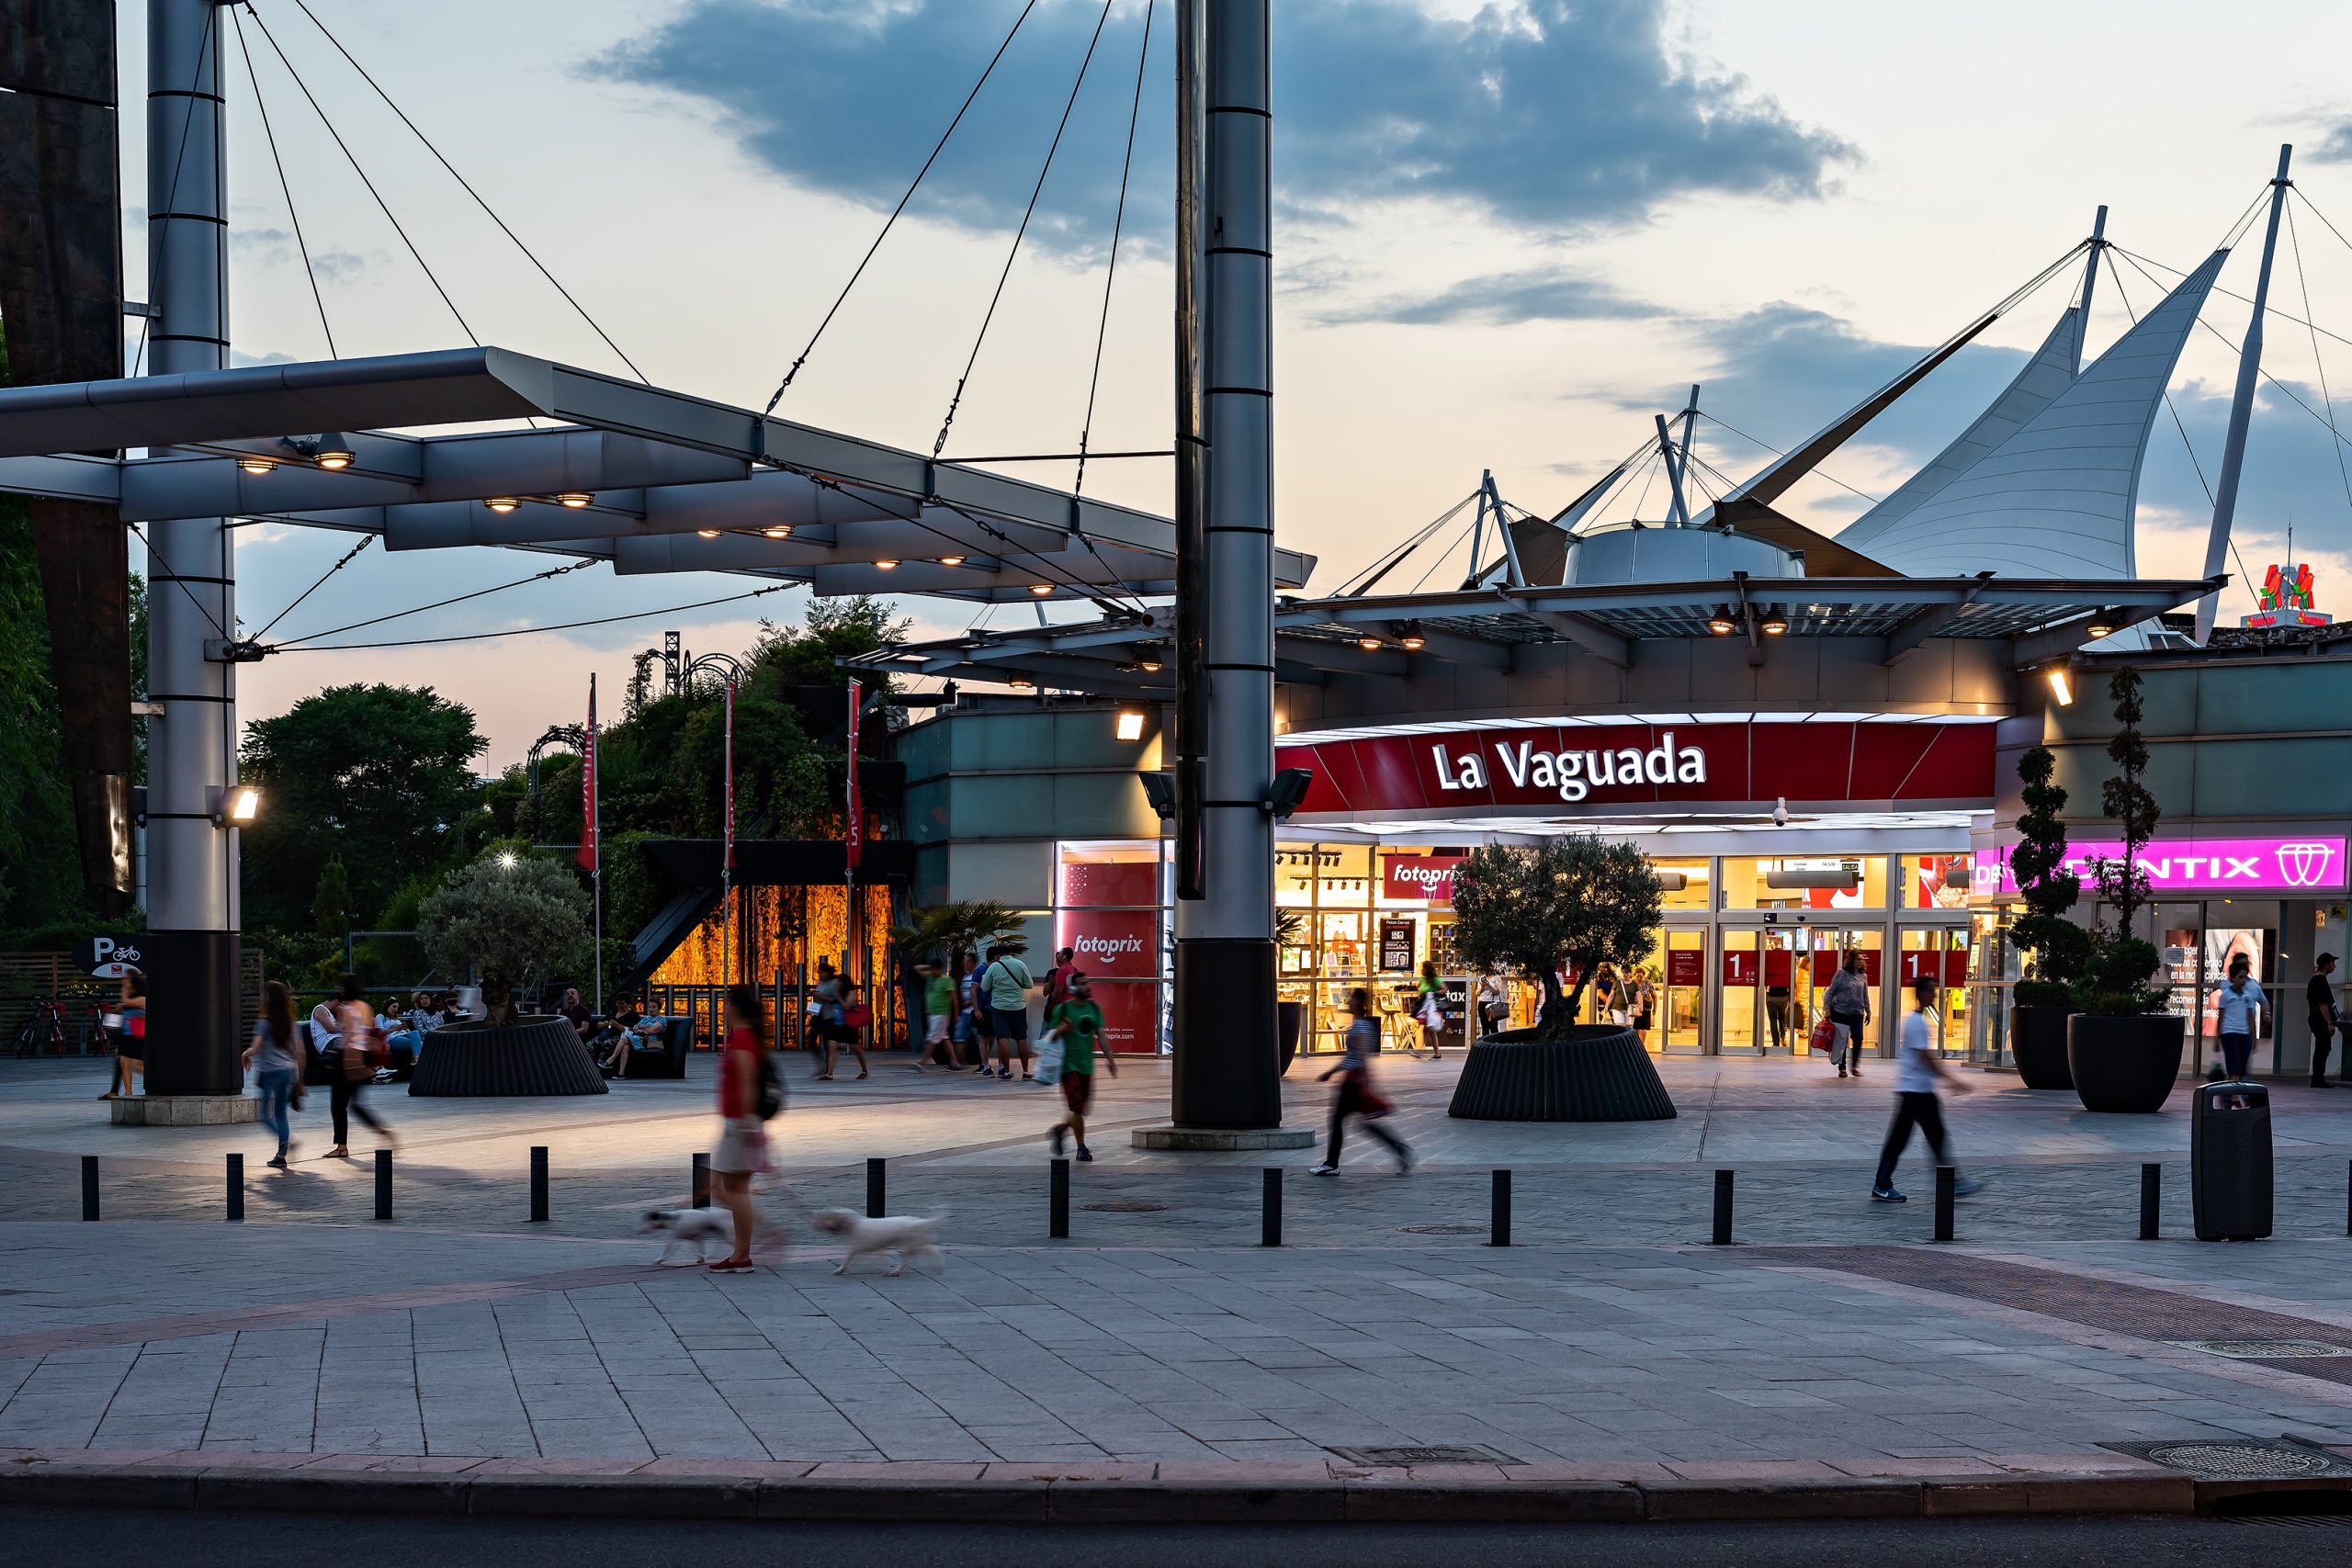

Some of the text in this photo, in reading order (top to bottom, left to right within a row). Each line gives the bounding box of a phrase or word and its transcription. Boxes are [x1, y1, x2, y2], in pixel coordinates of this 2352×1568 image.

[1431, 731, 1707, 802] La Vaguada
[1394, 863, 1456, 886] fotopri
[94, 937, 115, 963] P
[1074, 933, 1143, 956] fotoprix
[1729, 953, 1740, 977] 1
[1907, 953, 1918, 978] 1
[2170, 971, 2178, 980] en
[2178, 969, 2185, 980] la
[2185, 969, 2196, 980] red
[1445, 989, 1465, 1002] tax
[2180, 1008, 2191, 1017] sus
